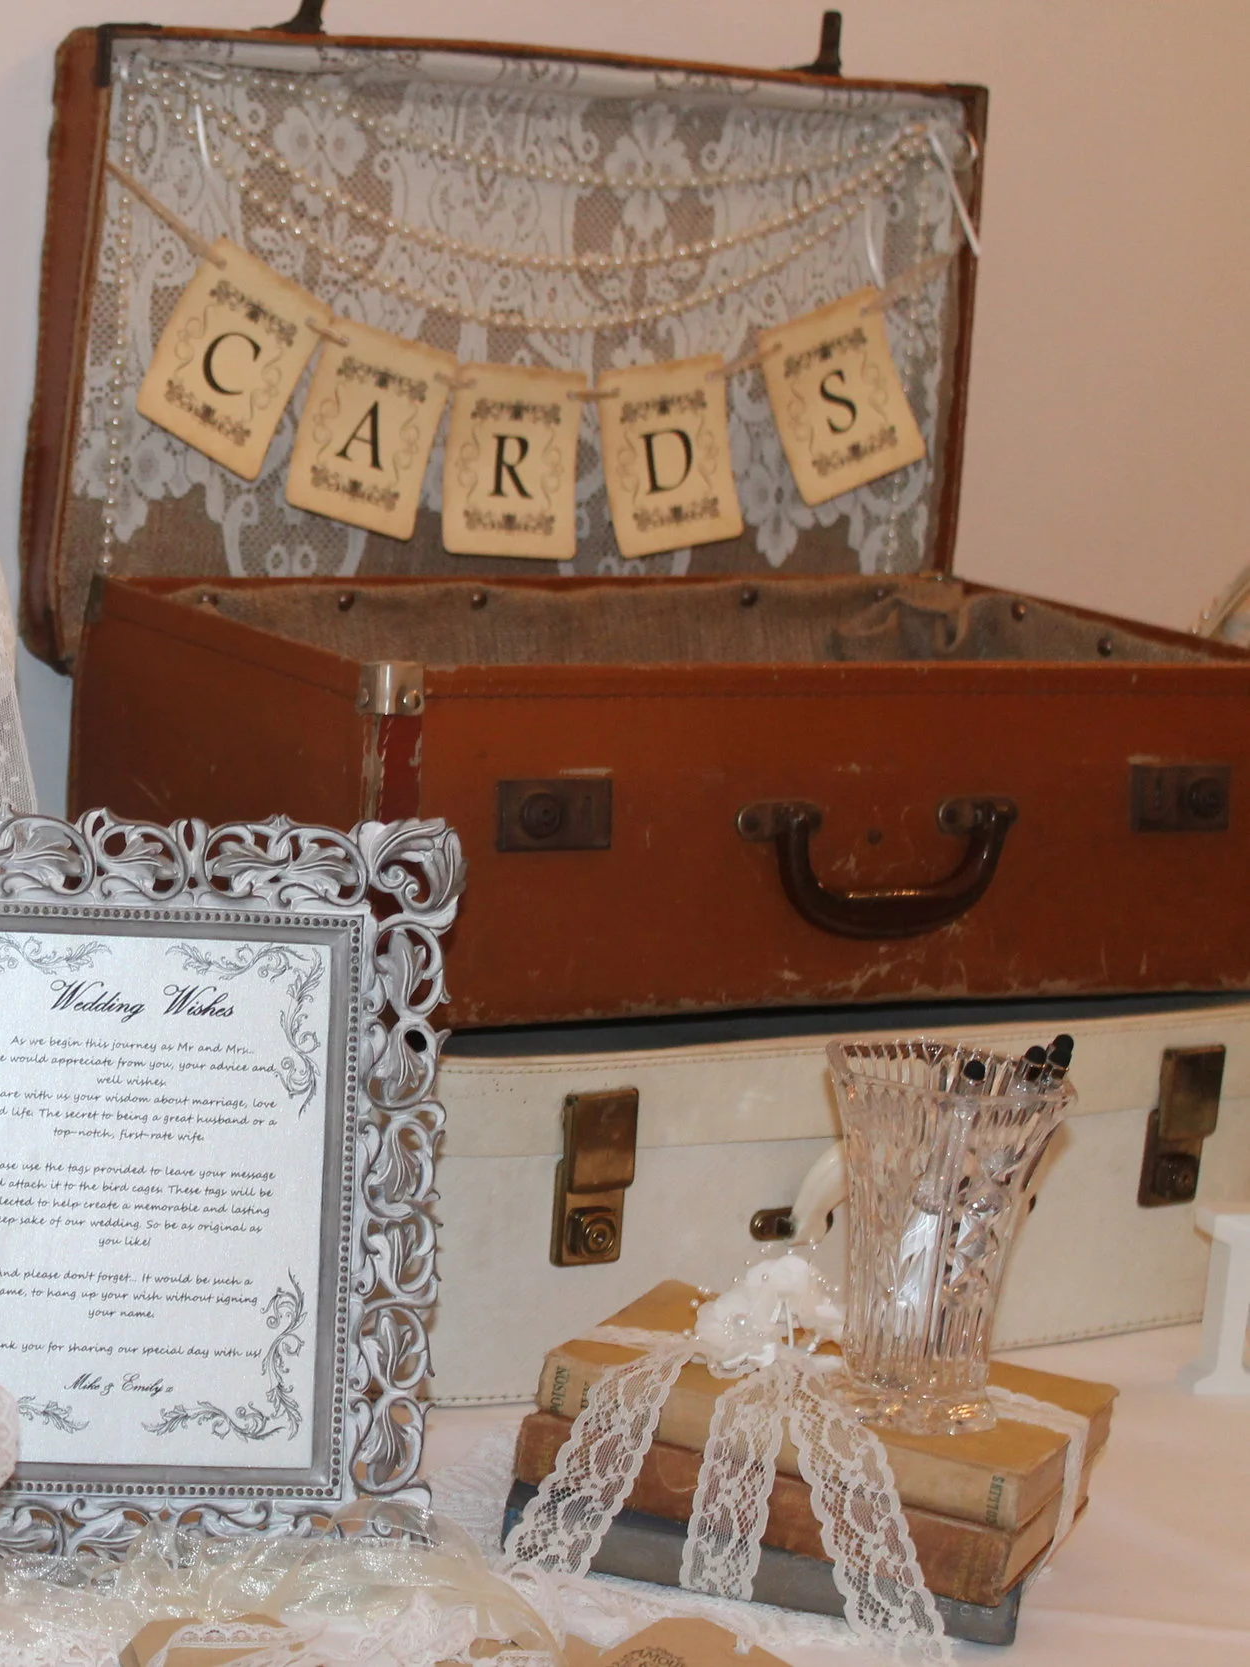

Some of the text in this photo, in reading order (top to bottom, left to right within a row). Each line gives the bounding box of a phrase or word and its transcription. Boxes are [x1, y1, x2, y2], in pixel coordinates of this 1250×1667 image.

[50, 979, 234, 1024] Wedding Wishes
[11, 1035, 24, 1046] As
[30, 1038, 45, 1046] we
[50, 1036, 82, 1049] begin
[86, 1037, 109, 1049] this
[111, 1039, 157, 1053] journey
[161, 1043, 174, 1052] as
[177, 1041, 194, 1052] Mr
[198, 1043, 222, 1053] and
[11, 1053, 47, 1064] would
[51, 1055, 114, 1068] appreciate
[117, 1056, 146, 1070] from
[179, 1062, 206, 1073] your
[210, 1060, 249, 1072] advice
[252, 1063, 277, 1073] and
[97, 1074, 123, 1085] well
[24, 1089, 52, 1100] with
[56, 1093, 70, 1101] us
[73, 1093, 101, 1104] your
[105, 1092, 150, 1104] wisdom
[154, 1094, 189, 1105] about
[253, 1098, 277, 1108] love
[39, 1107, 62, 1119] The
[65, 1110, 99, 1120] secret
[102, 1110, 113, 1120] to
[116, 1109, 148, 1125] being
[152, 1114, 161, 1122] a
[164, 1113, 194, 1125] great
[196, 1113, 249, 1125] husband
[253, 1118, 264, 1126] or
[269, 1119, 278, 1127] a
[22, 1163, 42, 1172] use
[45, 1161, 65, 1172] the
[68, 1162, 90, 1176] tags
[93, 1164, 148, 1176] provided
[150, 1166, 162, 1176] to
[165, 1165, 196, 1177] leave
[199, 1170, 227, 1180] your
[230, 1171, 277, 1183] message
[9, 1178, 47, 1190] attach
[50, 1179, 61, 1190] it
[64, 1181, 75, 1191] to
[79, 1180, 99, 1192] the
[102, 1181, 129, 1193] bird
[168, 1184, 202, 1196] These
[204, 1185, 228, 1199] tags
[230, 1186, 257, 1197] will
[259, 1187, 274, 1198] be
[37, 1197, 48, 1208] to
[52, 1197, 81, 1211] help
[83, 1200, 120, 1211] create
[122, 1202, 131, 1210] a
[134, 1202, 200, 1213] memorable
[203, 1203, 228, 1214] and
[231, 1204, 271, 1218] lasting
[50, 1215, 63, 1229] of
[65, 1218, 86, 1227] our
[90, 1217, 143, 1231] wedding.
[146, 1219, 161, 1230] So
[164, 1219, 179, 1231] be
[181, 1222, 195, 1231] as
[197, 1221, 247, 1234] original
[249, 1225, 263, 1234] as
[98, 1238, 123, 1248] you
[23, 1268, 61, 1281] please
[142, 1273, 151, 1284] It
[154, 1273, 193, 1284] would
[196, 1274, 210, 1285] be
[212, 1275, 242, 1286] such
[31, 1287, 42, 1298] to
[46, 1287, 77, 1301] hang
[81, 1291, 98, 1301] up
[100, 1291, 130, 1302] your
[133, 1290, 163, 1302] wish
[165, 1291, 213, 1304] without
[215, 1293, 258, 1307] signing
[88, 1309, 116, 1320] your
[21, 1343, 45, 1353] you
[47, 1340, 65, 1354] for
[67, 1342, 113, 1356] sharing
[117, 1346, 140, 1354] our
[142, 1345, 185, 1357] special
[187, 1345, 210, 1359] day
[214, 1346, 243, 1358] with
[64, 1373, 103, 1391] Mike
[121, 1373, 164, 1397] Emily
[986, 1475, 1005, 1525] COLLINS
